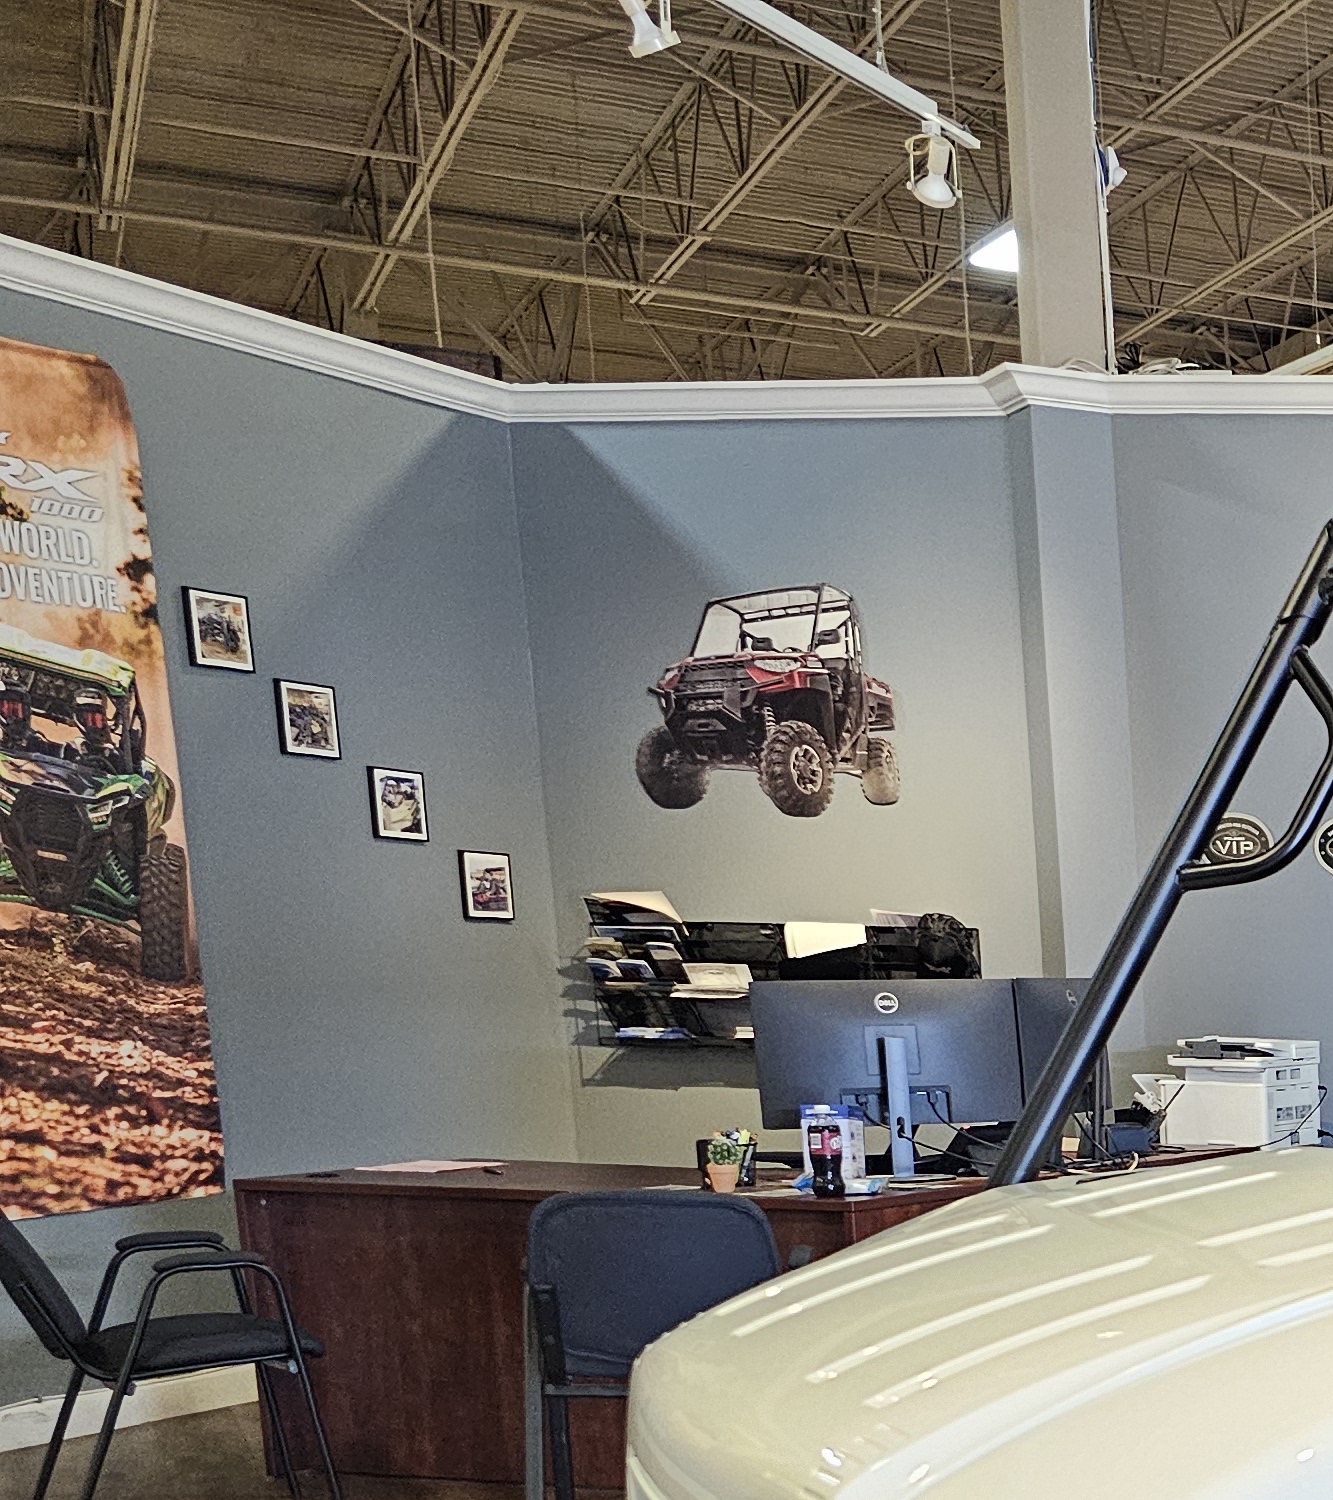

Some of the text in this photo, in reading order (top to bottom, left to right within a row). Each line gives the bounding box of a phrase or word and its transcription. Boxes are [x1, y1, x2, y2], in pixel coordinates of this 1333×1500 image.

[0, 453, 100, 502] RX
[30, 497, 103, 521] 1000
[0, 519, 99, 567] WORLD.
[0, 563, 127, 613] DVENTURE.
[1216, 839, 1254, 855] VIP
